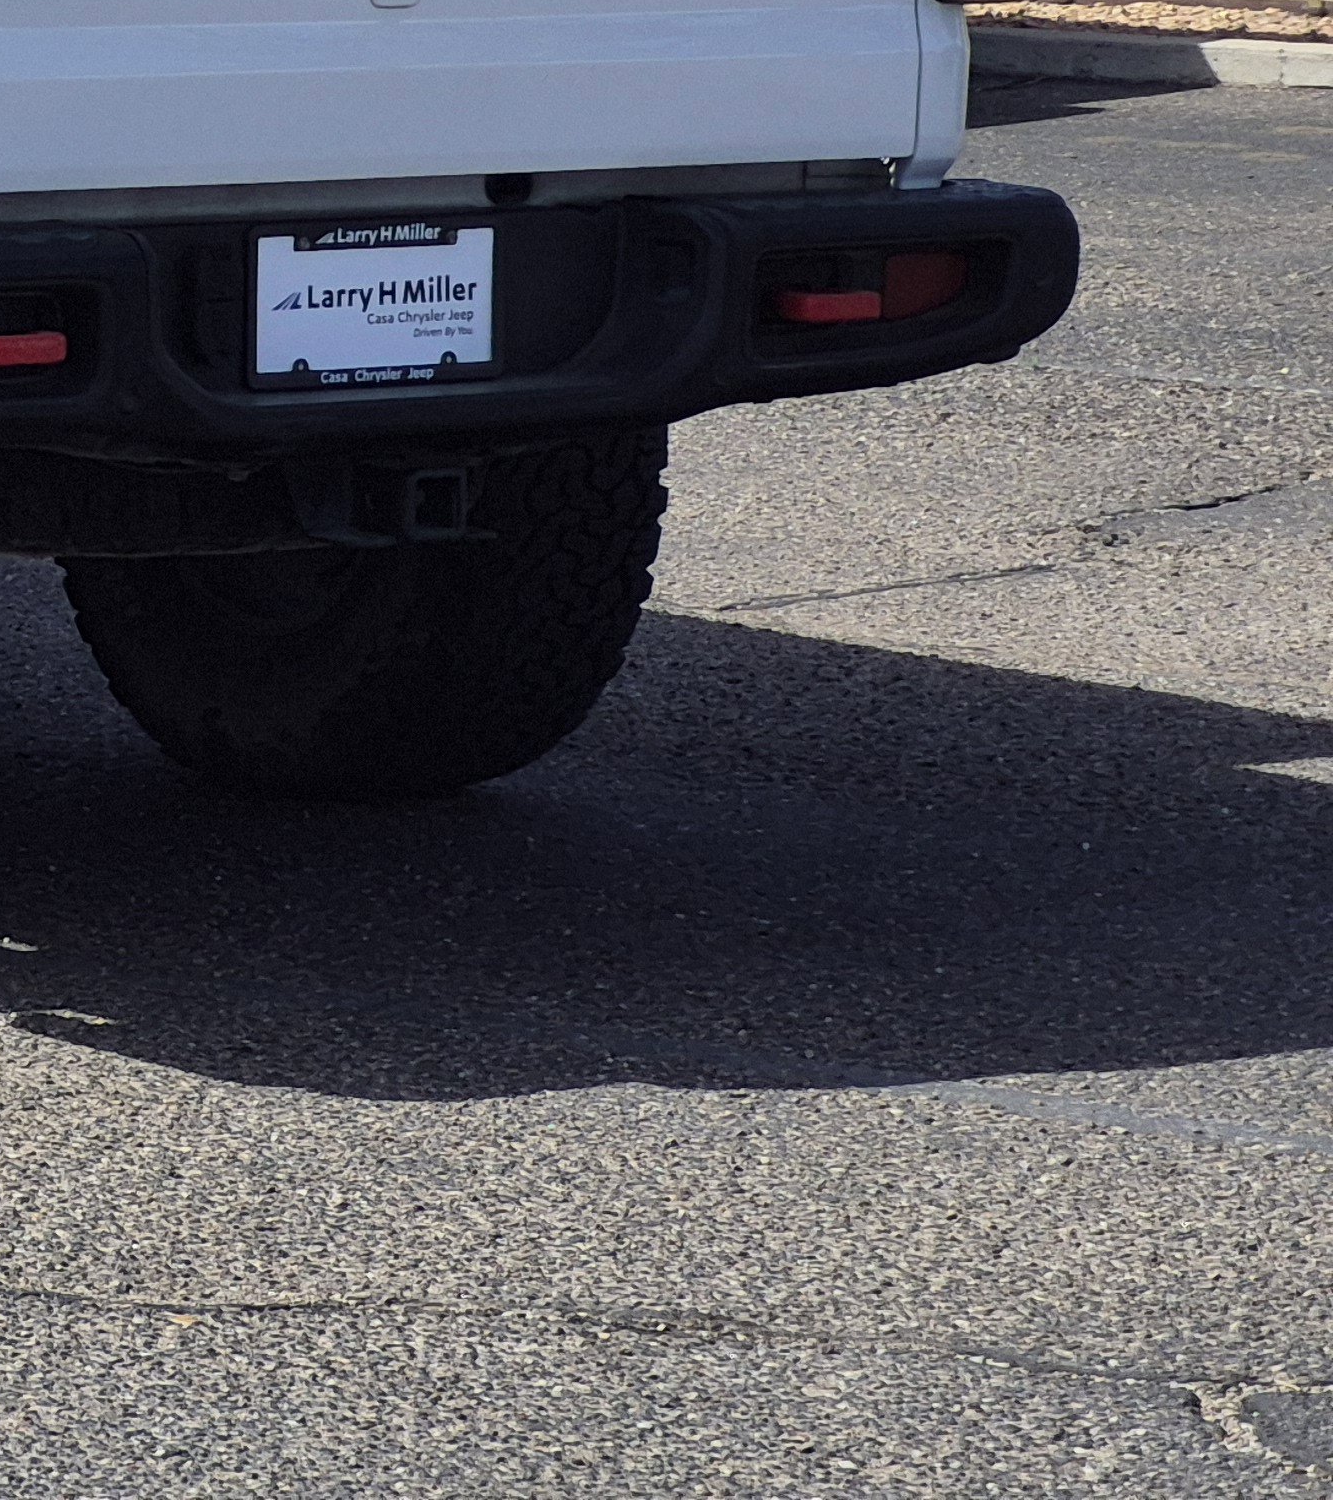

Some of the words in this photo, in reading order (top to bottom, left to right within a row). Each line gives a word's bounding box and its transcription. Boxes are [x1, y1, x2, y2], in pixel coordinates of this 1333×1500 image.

[337, 227, 378, 246] Larry
[380, 226, 392, 242] H
[394, 222, 442, 241] Miller
[307, 285, 374, 313] Larry
[379, 281, 397, 305] H
[402, 275, 477, 305] Miller
[367, 313, 395, 325] Casa
[398, 309, 445, 325] Chrysler
[448, 310, 474, 323] Jeep
[413, 327, 442, 338] Driven
[445, 327, 456, 337] By
[320, 371, 348, 384] Casa
[354, 367, 403, 383] Chrysler
[407, 367, 434, 380] Jeep
